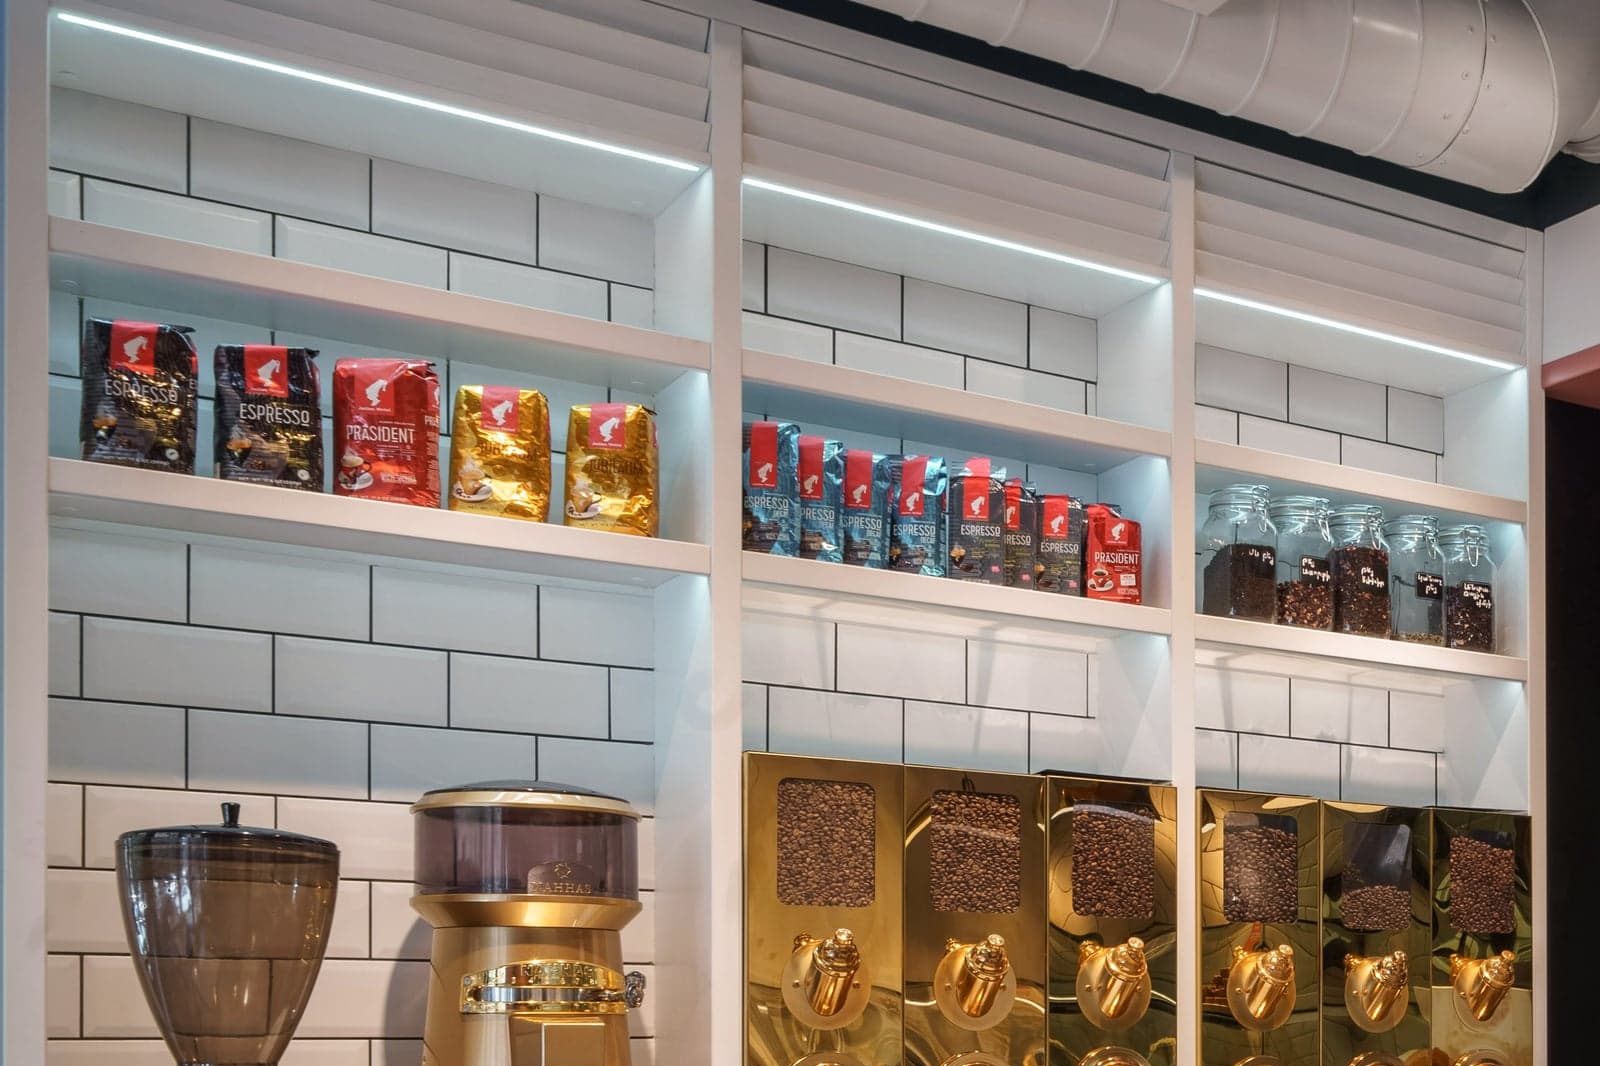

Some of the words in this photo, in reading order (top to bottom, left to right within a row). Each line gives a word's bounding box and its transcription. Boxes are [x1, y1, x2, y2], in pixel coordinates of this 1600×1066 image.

[104, 379, 179, 405] ESPRESSO
[239, 402, 310, 427] ESPRESSO
[744, 495, 789, 511] ESPRESSO
[800, 506, 836, 522] PRESSO
[893, 523, 936, 538] ESPRESSO
[960, 524, 1001, 538] ESPRESSO
[1040, 541, 1079, 554] ESPRESSO
